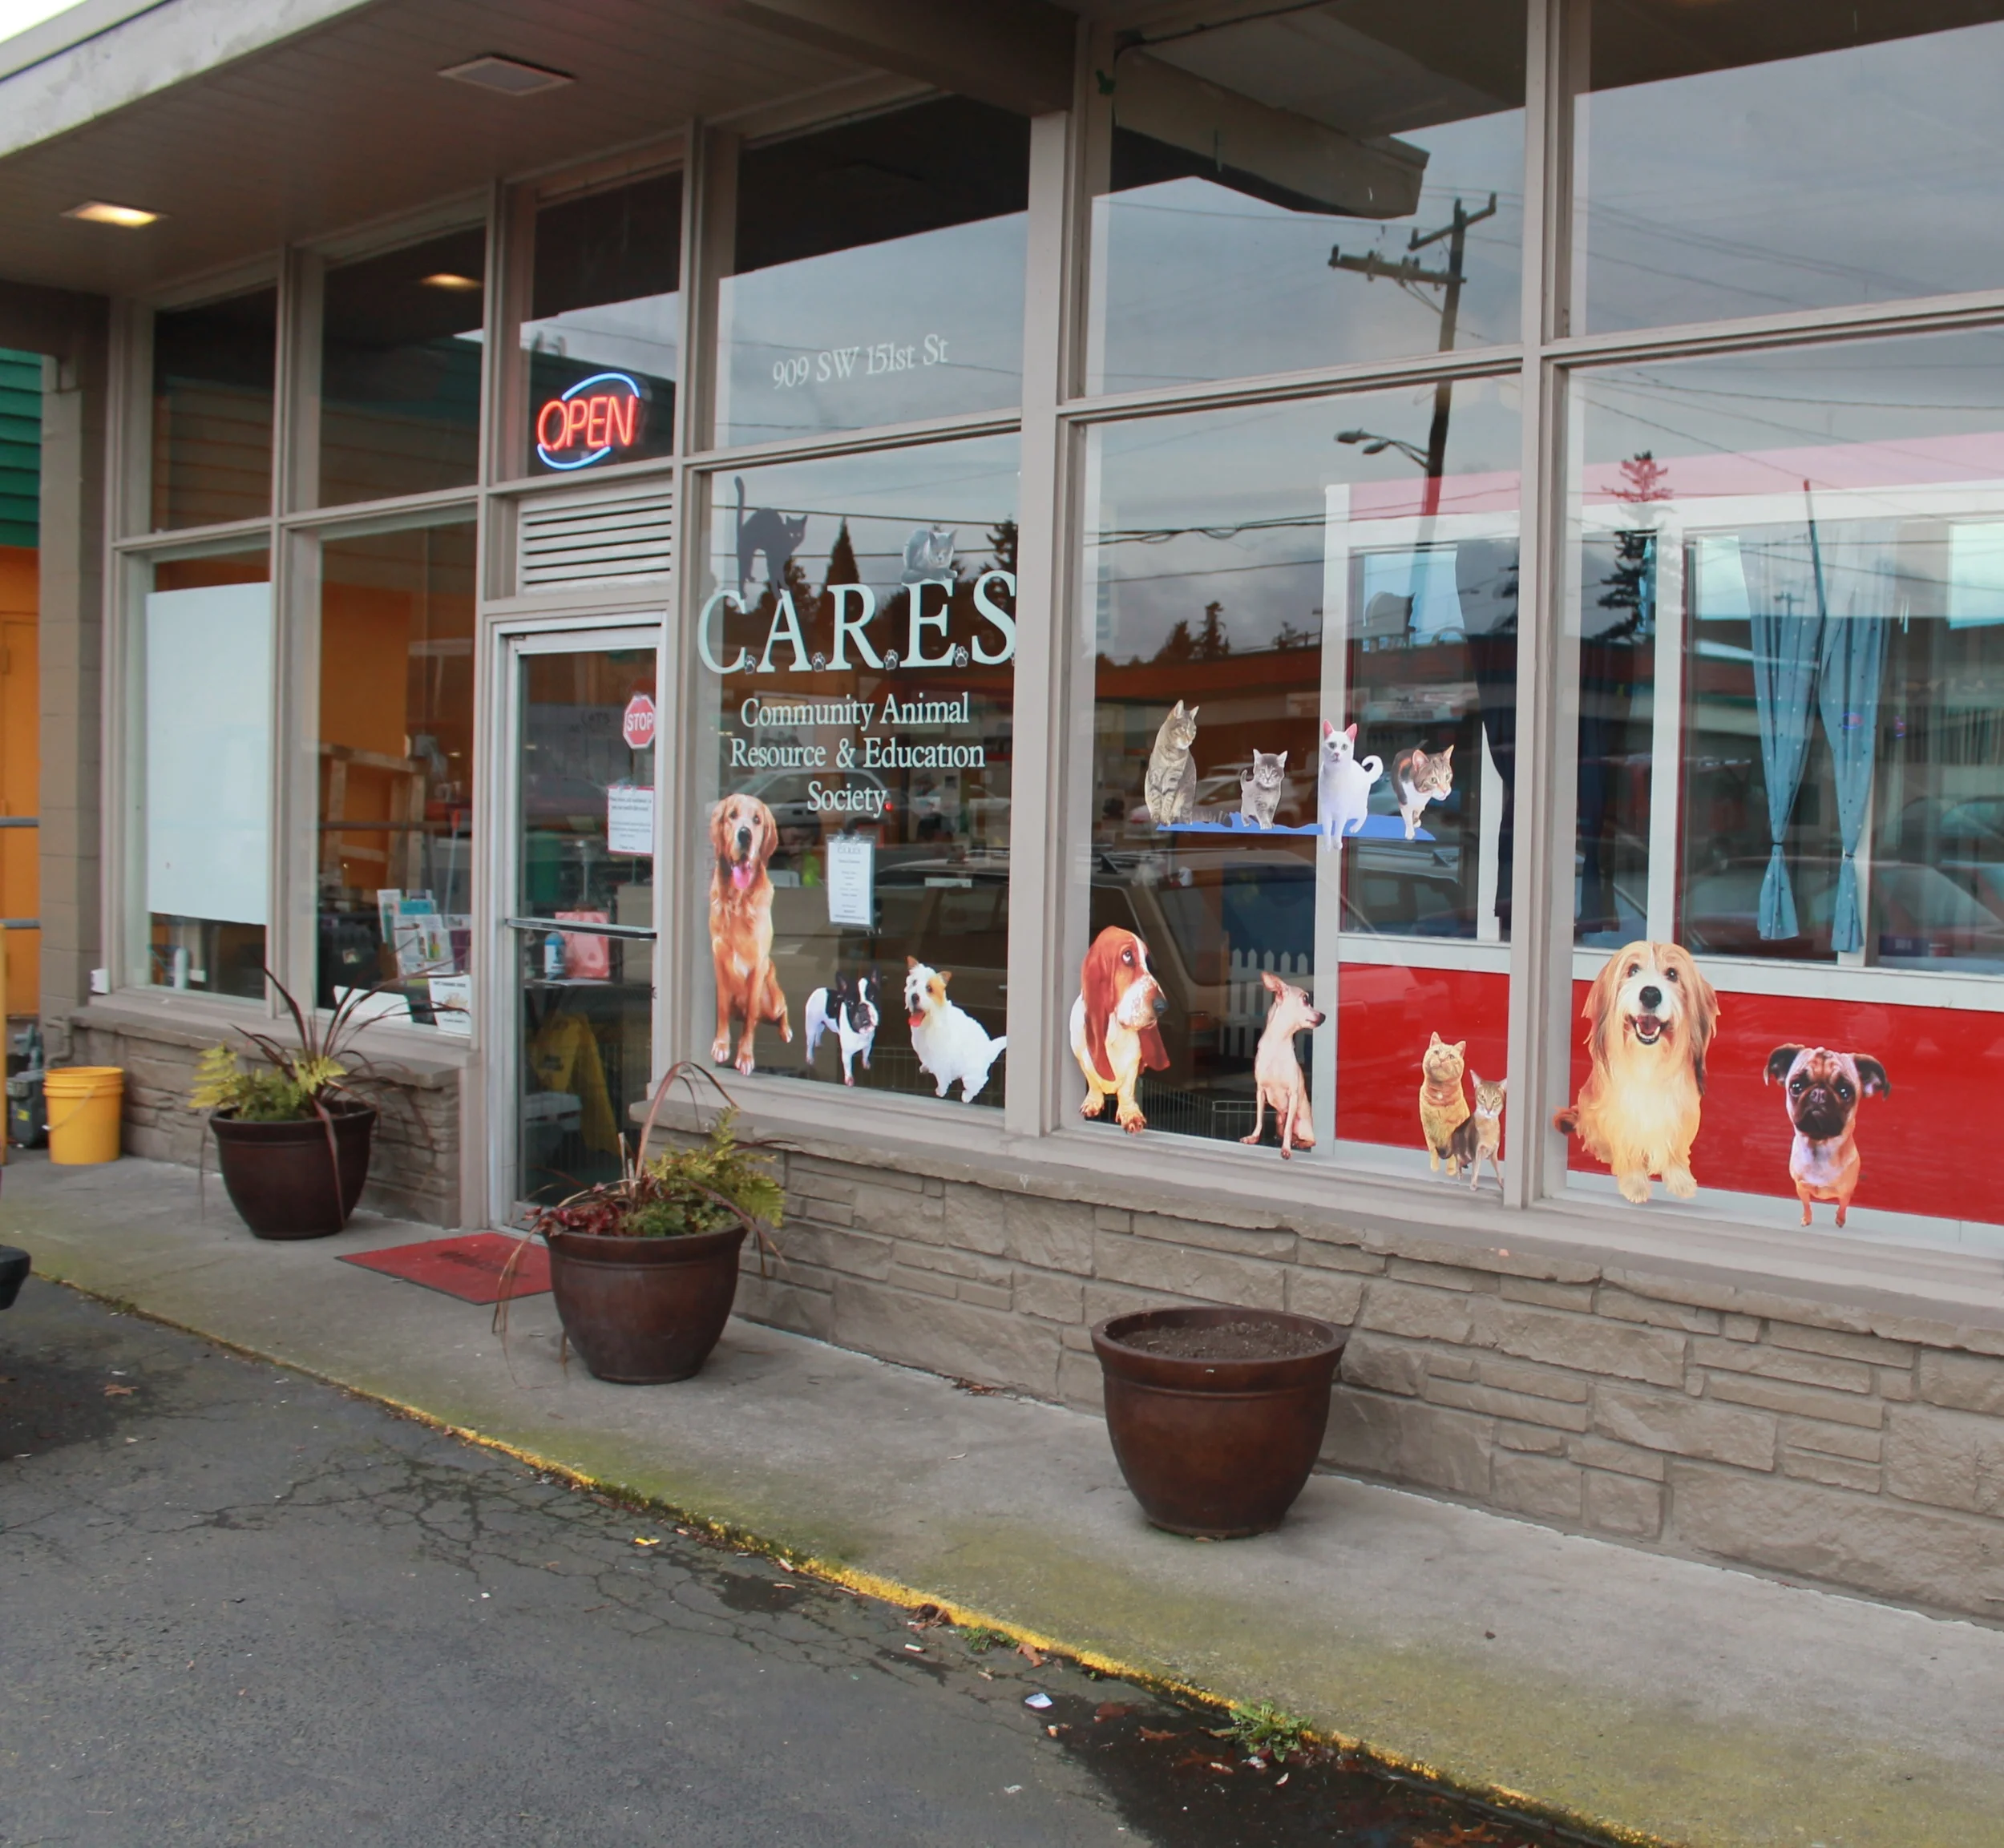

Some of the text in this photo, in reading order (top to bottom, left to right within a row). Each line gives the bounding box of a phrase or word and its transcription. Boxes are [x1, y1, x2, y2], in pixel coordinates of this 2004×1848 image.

[773, 333, 949, 389] 909 SW 151st St
[536, 394, 636, 452] OPEN
[627, 712, 653, 732] STOP
[741, 692, 970, 732] Community Animal
[729, 736, 986, 769] Resource & Education
[807, 780, 887, 818] Society
